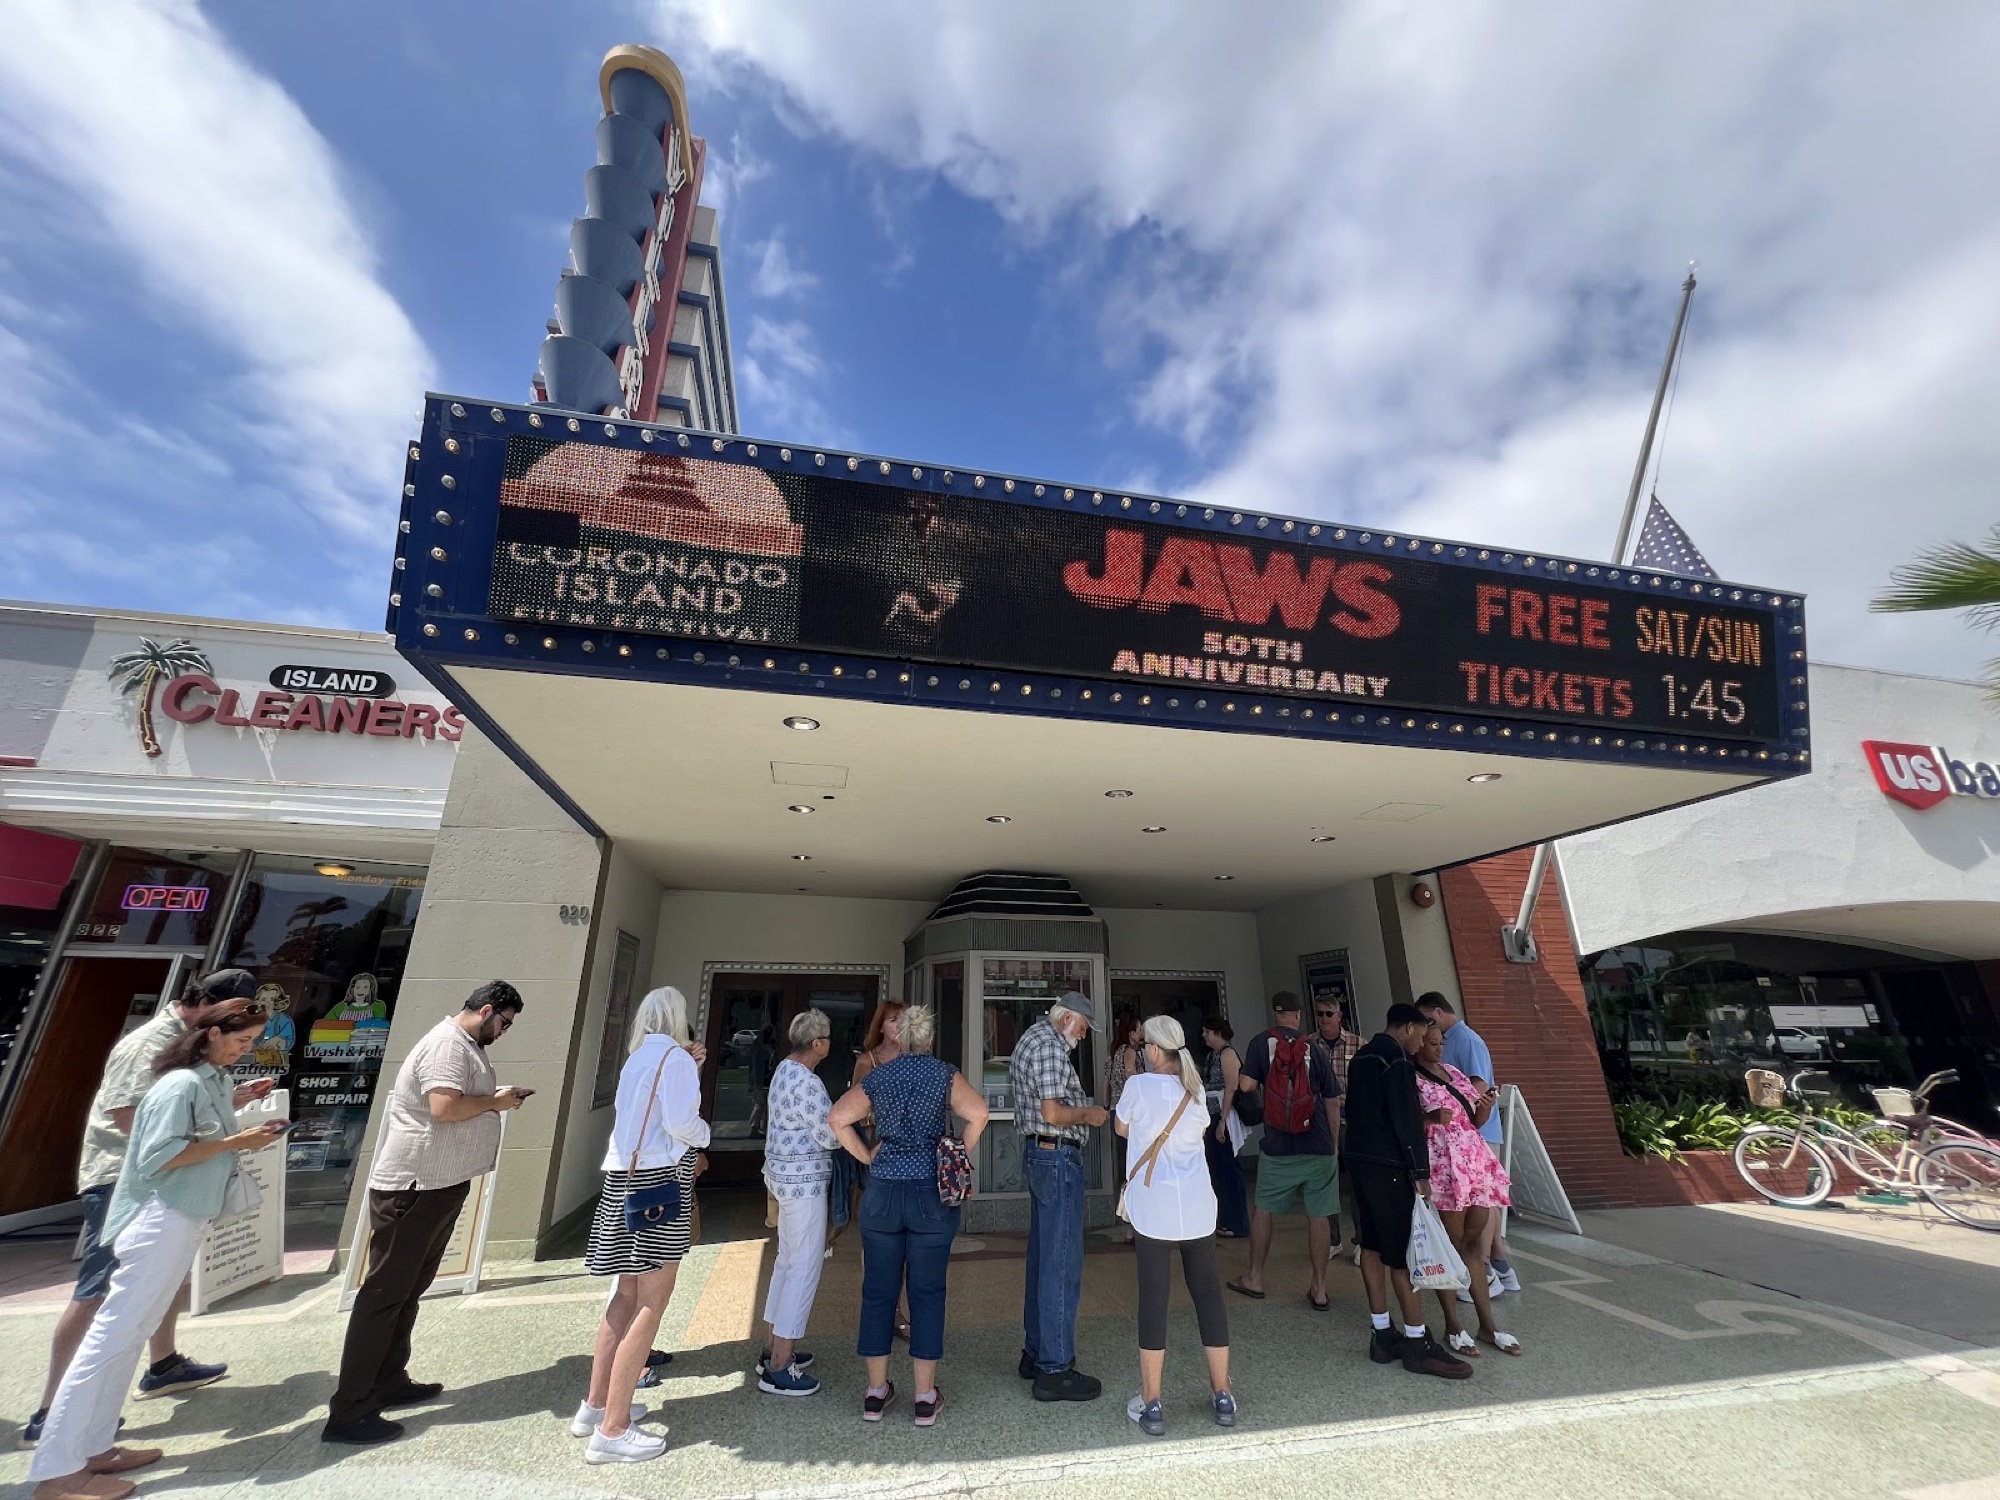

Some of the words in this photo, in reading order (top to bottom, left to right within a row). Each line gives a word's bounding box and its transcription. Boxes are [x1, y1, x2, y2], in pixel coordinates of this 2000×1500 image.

[508, 541, 787, 588] CORONADO
[553, 572, 743, 615] ISLAND
[1063, 528, 1401, 639] JAWS
[1476, 584, 1610, 650] FREE
[1635, 605, 1762, 667] SAT/SUN
[1203, 630, 1304, 662] 50TH
[282, 669, 378, 692] ISLAND
[1112, 649, 1390, 697] ANNIVERSARY
[161, 673, 465, 741] CLEANERS
[1459, 661, 1635, 717] TICKETS
[1661, 674, 1746, 724] 1:45
[1938, 746, 2000, 797] ba
[336, 873, 386, 885] Monday
[395, 876, 427, 888] Frida
[128, 888, 205, 909] OPEN
[560, 905, 590, 920] 820
[76, 924, 121, 936] 822
[305, 1045, 344, 1057] Wash
[346, 1045, 357, 1057] &
[299, 1077, 339, 1088] SHOE
[315, 1094, 369, 1105] REPAIR
